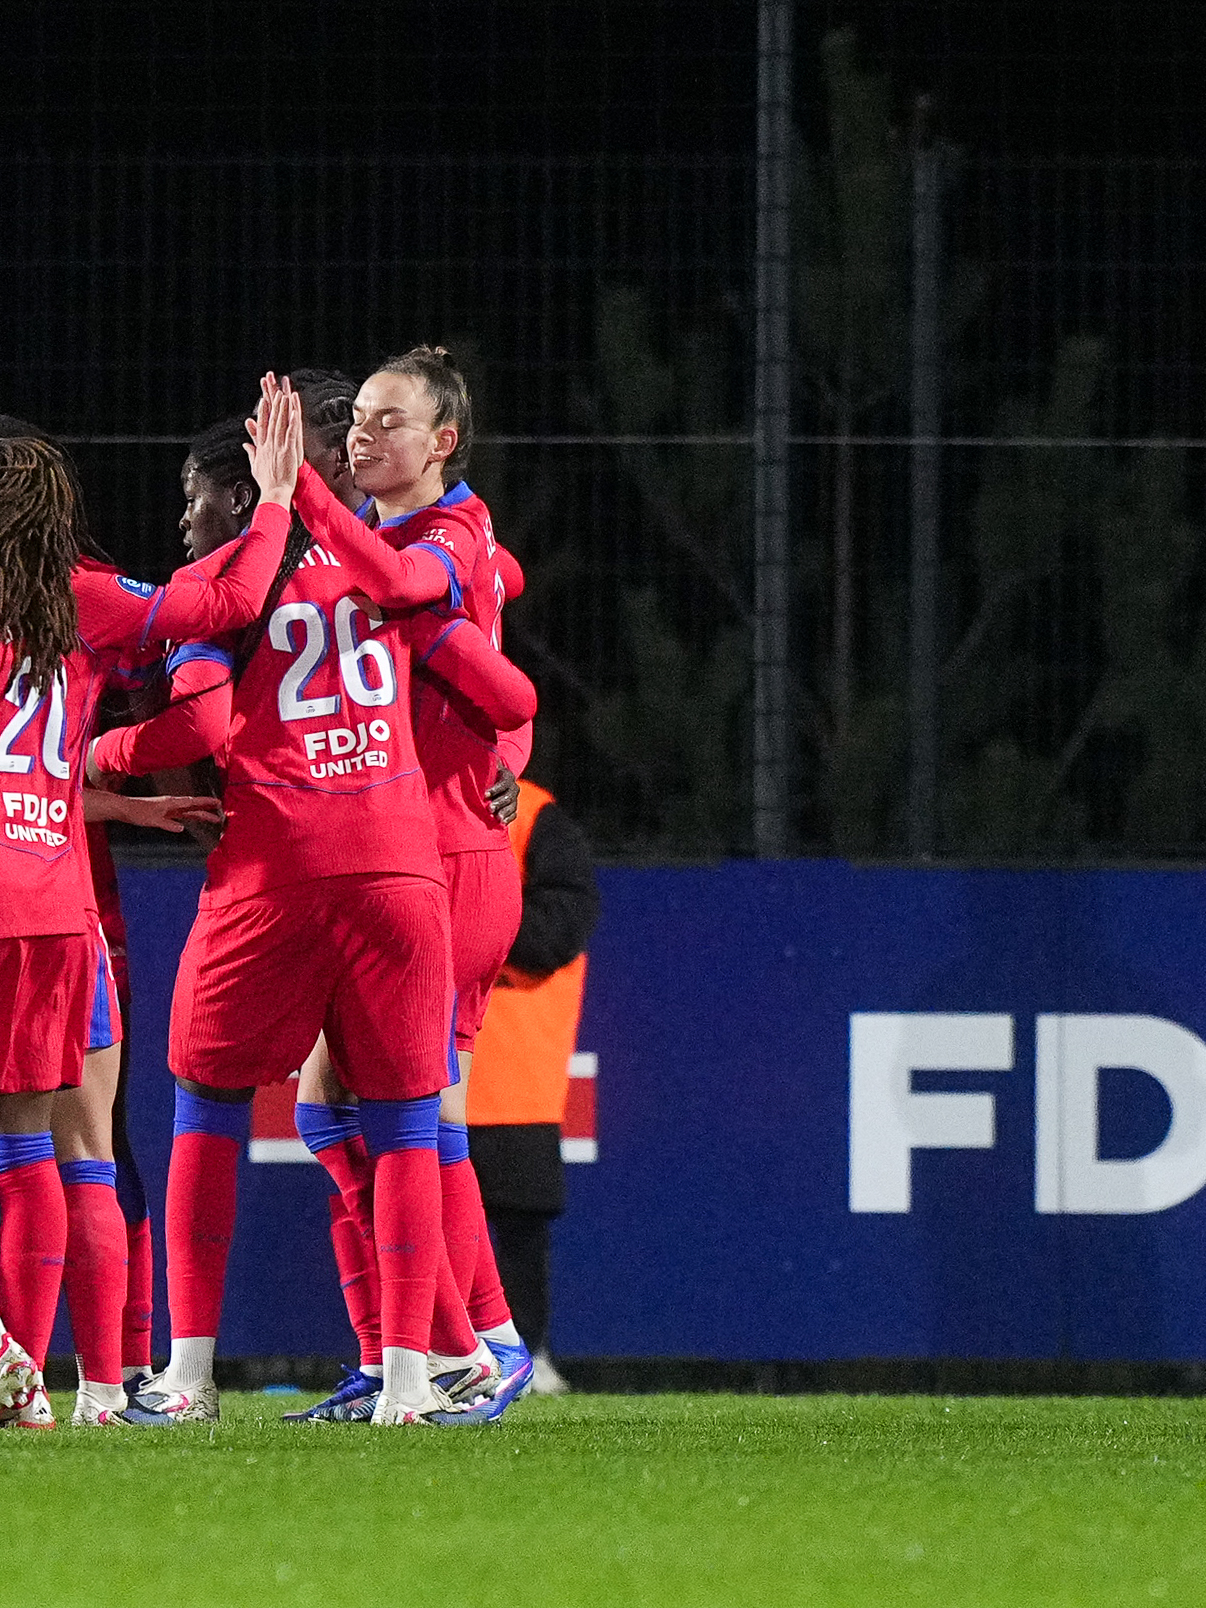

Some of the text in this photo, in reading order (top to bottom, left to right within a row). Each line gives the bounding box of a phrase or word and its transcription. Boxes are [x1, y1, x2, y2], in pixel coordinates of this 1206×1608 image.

[269, 596, 396, 721] 26
[310, 750, 388, 779] UNITED
[5, 823, 68, 848] UNITED
